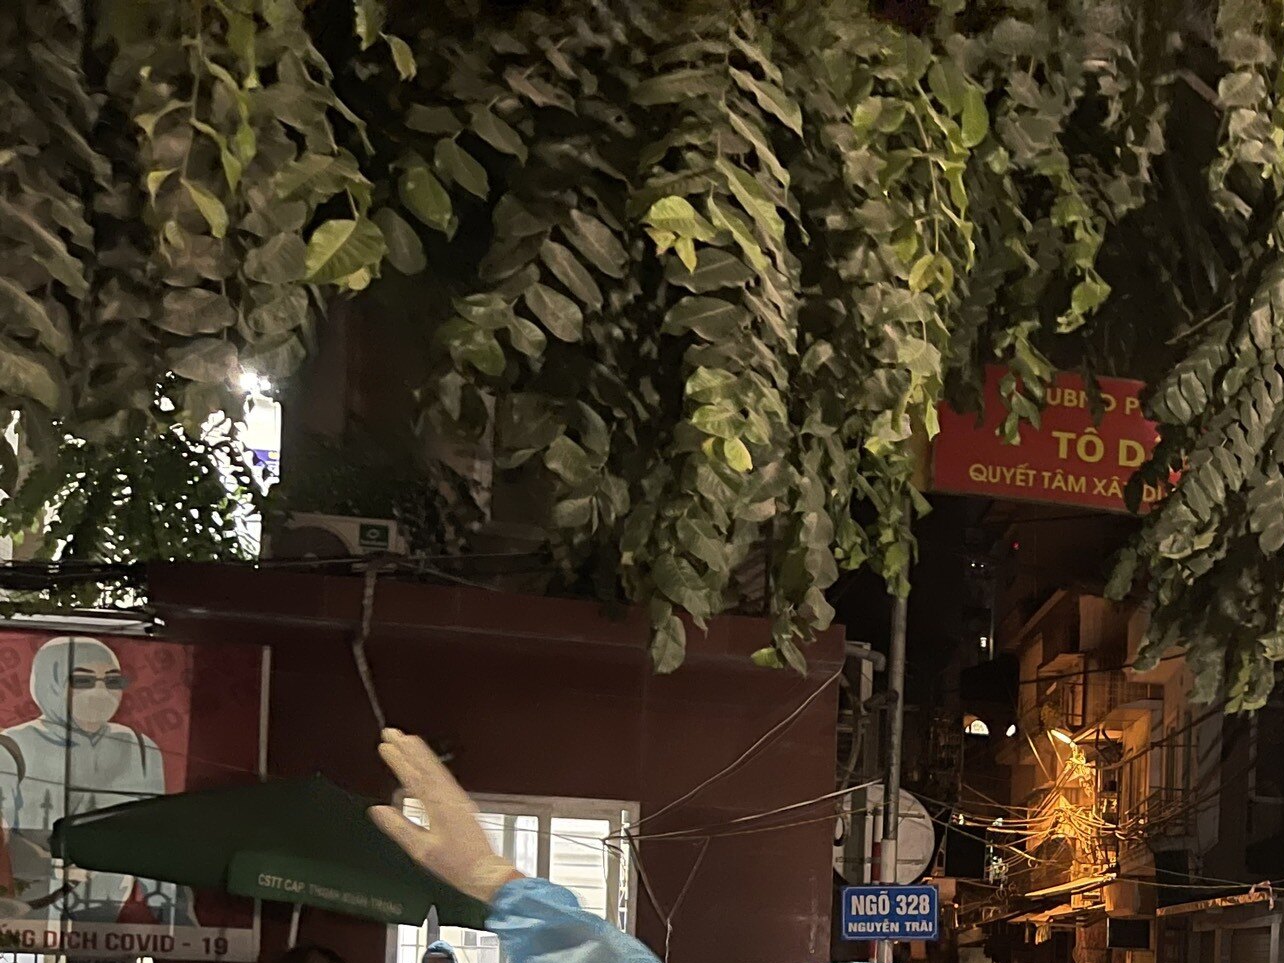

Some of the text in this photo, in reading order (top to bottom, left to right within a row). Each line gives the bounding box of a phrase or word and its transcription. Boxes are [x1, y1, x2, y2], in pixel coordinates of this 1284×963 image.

[968, 463, 1037, 487] QUYẾT
[1041, 468, 1087, 494] TÂM
[1092, 475, 1127, 499] XÂ
[258, 873, 282, 890] CSTT
[851, 890, 930, 916] NGÕ 328
[905, 920, 933, 932] TRÃI
[105, 932, 175, 952] COVID
[201, 937, 229, 955] 19
